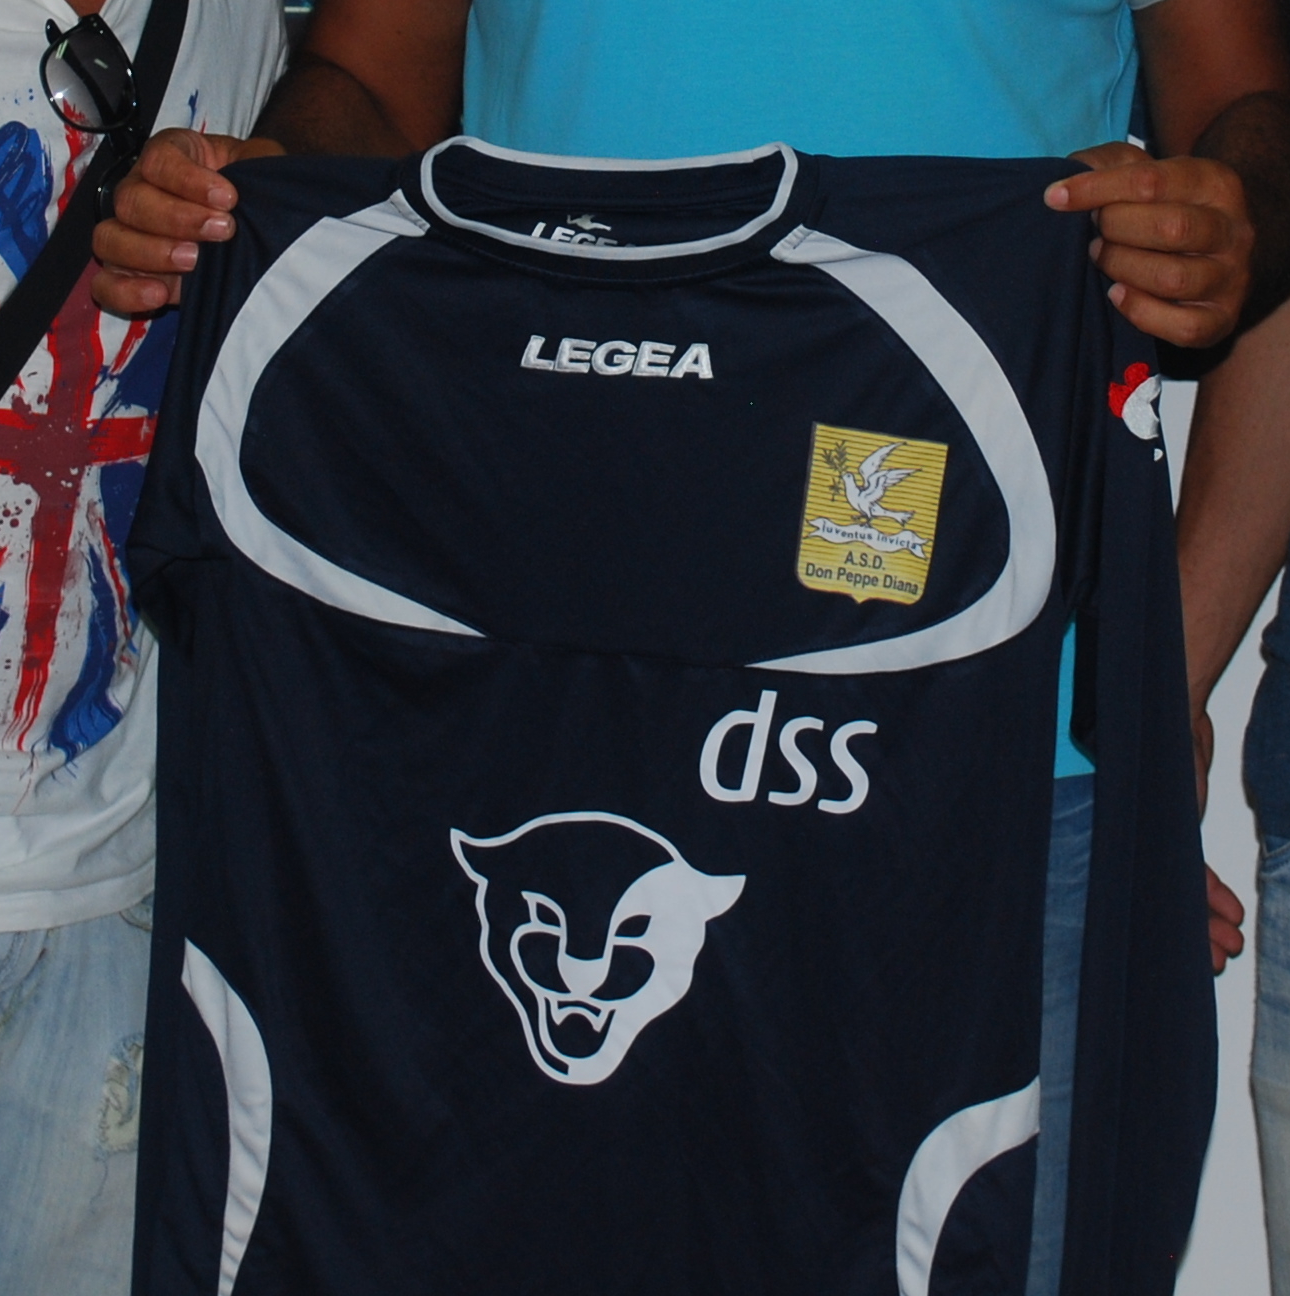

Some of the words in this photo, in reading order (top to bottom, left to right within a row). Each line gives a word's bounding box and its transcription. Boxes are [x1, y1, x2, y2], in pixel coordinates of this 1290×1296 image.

[520, 335, 714, 380] LEGEA
[805, 562, 833, 580] Don
[837, 568, 879, 589] Peppe
[883, 575, 918, 595] Diana
[845, 551, 886, 571] A.S.D.
[698, 690, 878, 814] dss
